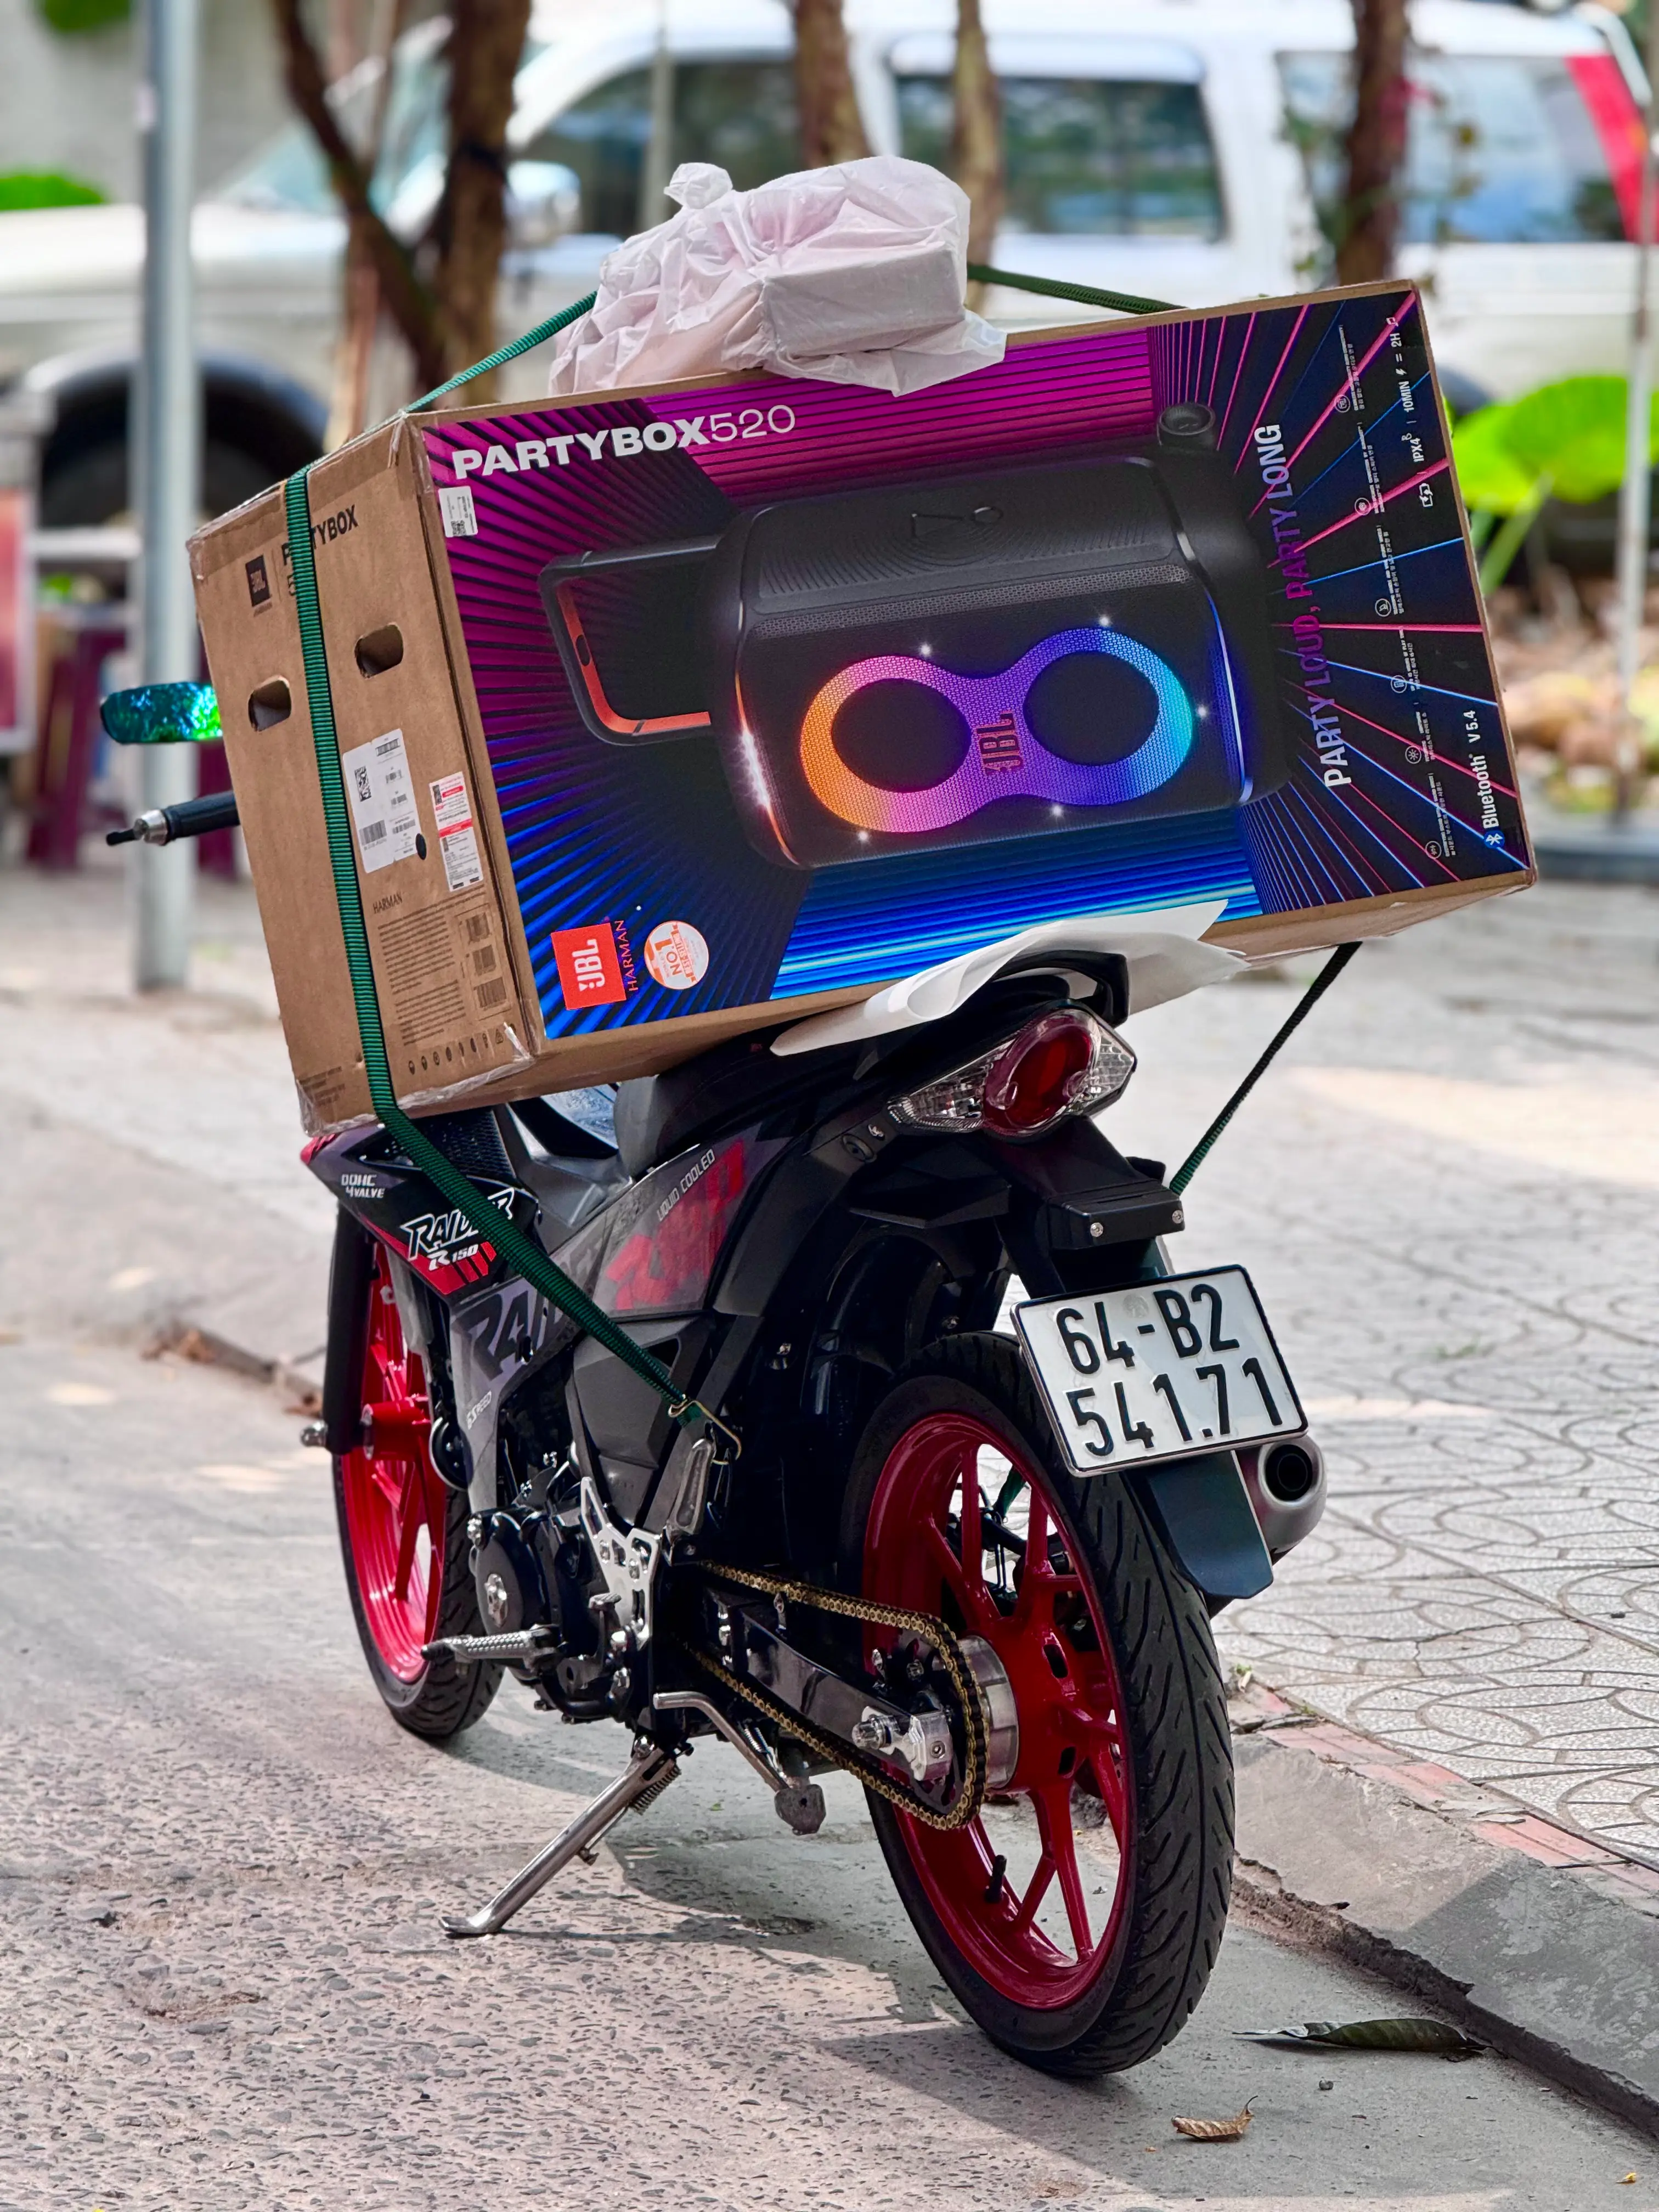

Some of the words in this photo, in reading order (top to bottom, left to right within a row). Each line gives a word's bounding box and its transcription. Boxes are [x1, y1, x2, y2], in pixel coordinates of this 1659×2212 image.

[1390, 332, 1402, 347] 2H
[1399, 381, 1414, 412] 10MIN
[1254, 424, 1294, 499] LONG
[1409, 437, 1424, 462] IPX4
[281, 504, 358, 566] PTYBOX
[1269, 507, 1314, 600] PARTY
[1293, 606, 1331, 687] LOUD,
[976, 712, 1024, 774] JBL
[1309, 696, 1351, 787] PARTY
[572, 939, 605, 992] JBL
[614, 920, 639, 991] HARMAN
[341, 1174, 377, 1187] DOHC
[657, 1188, 680, 1222] LIQUID
[680, 1149, 715, 1194] COOLED
[1056, 1283, 1240, 1375] 64-B2
[1065, 1357, 1283, 1457] 541.71
